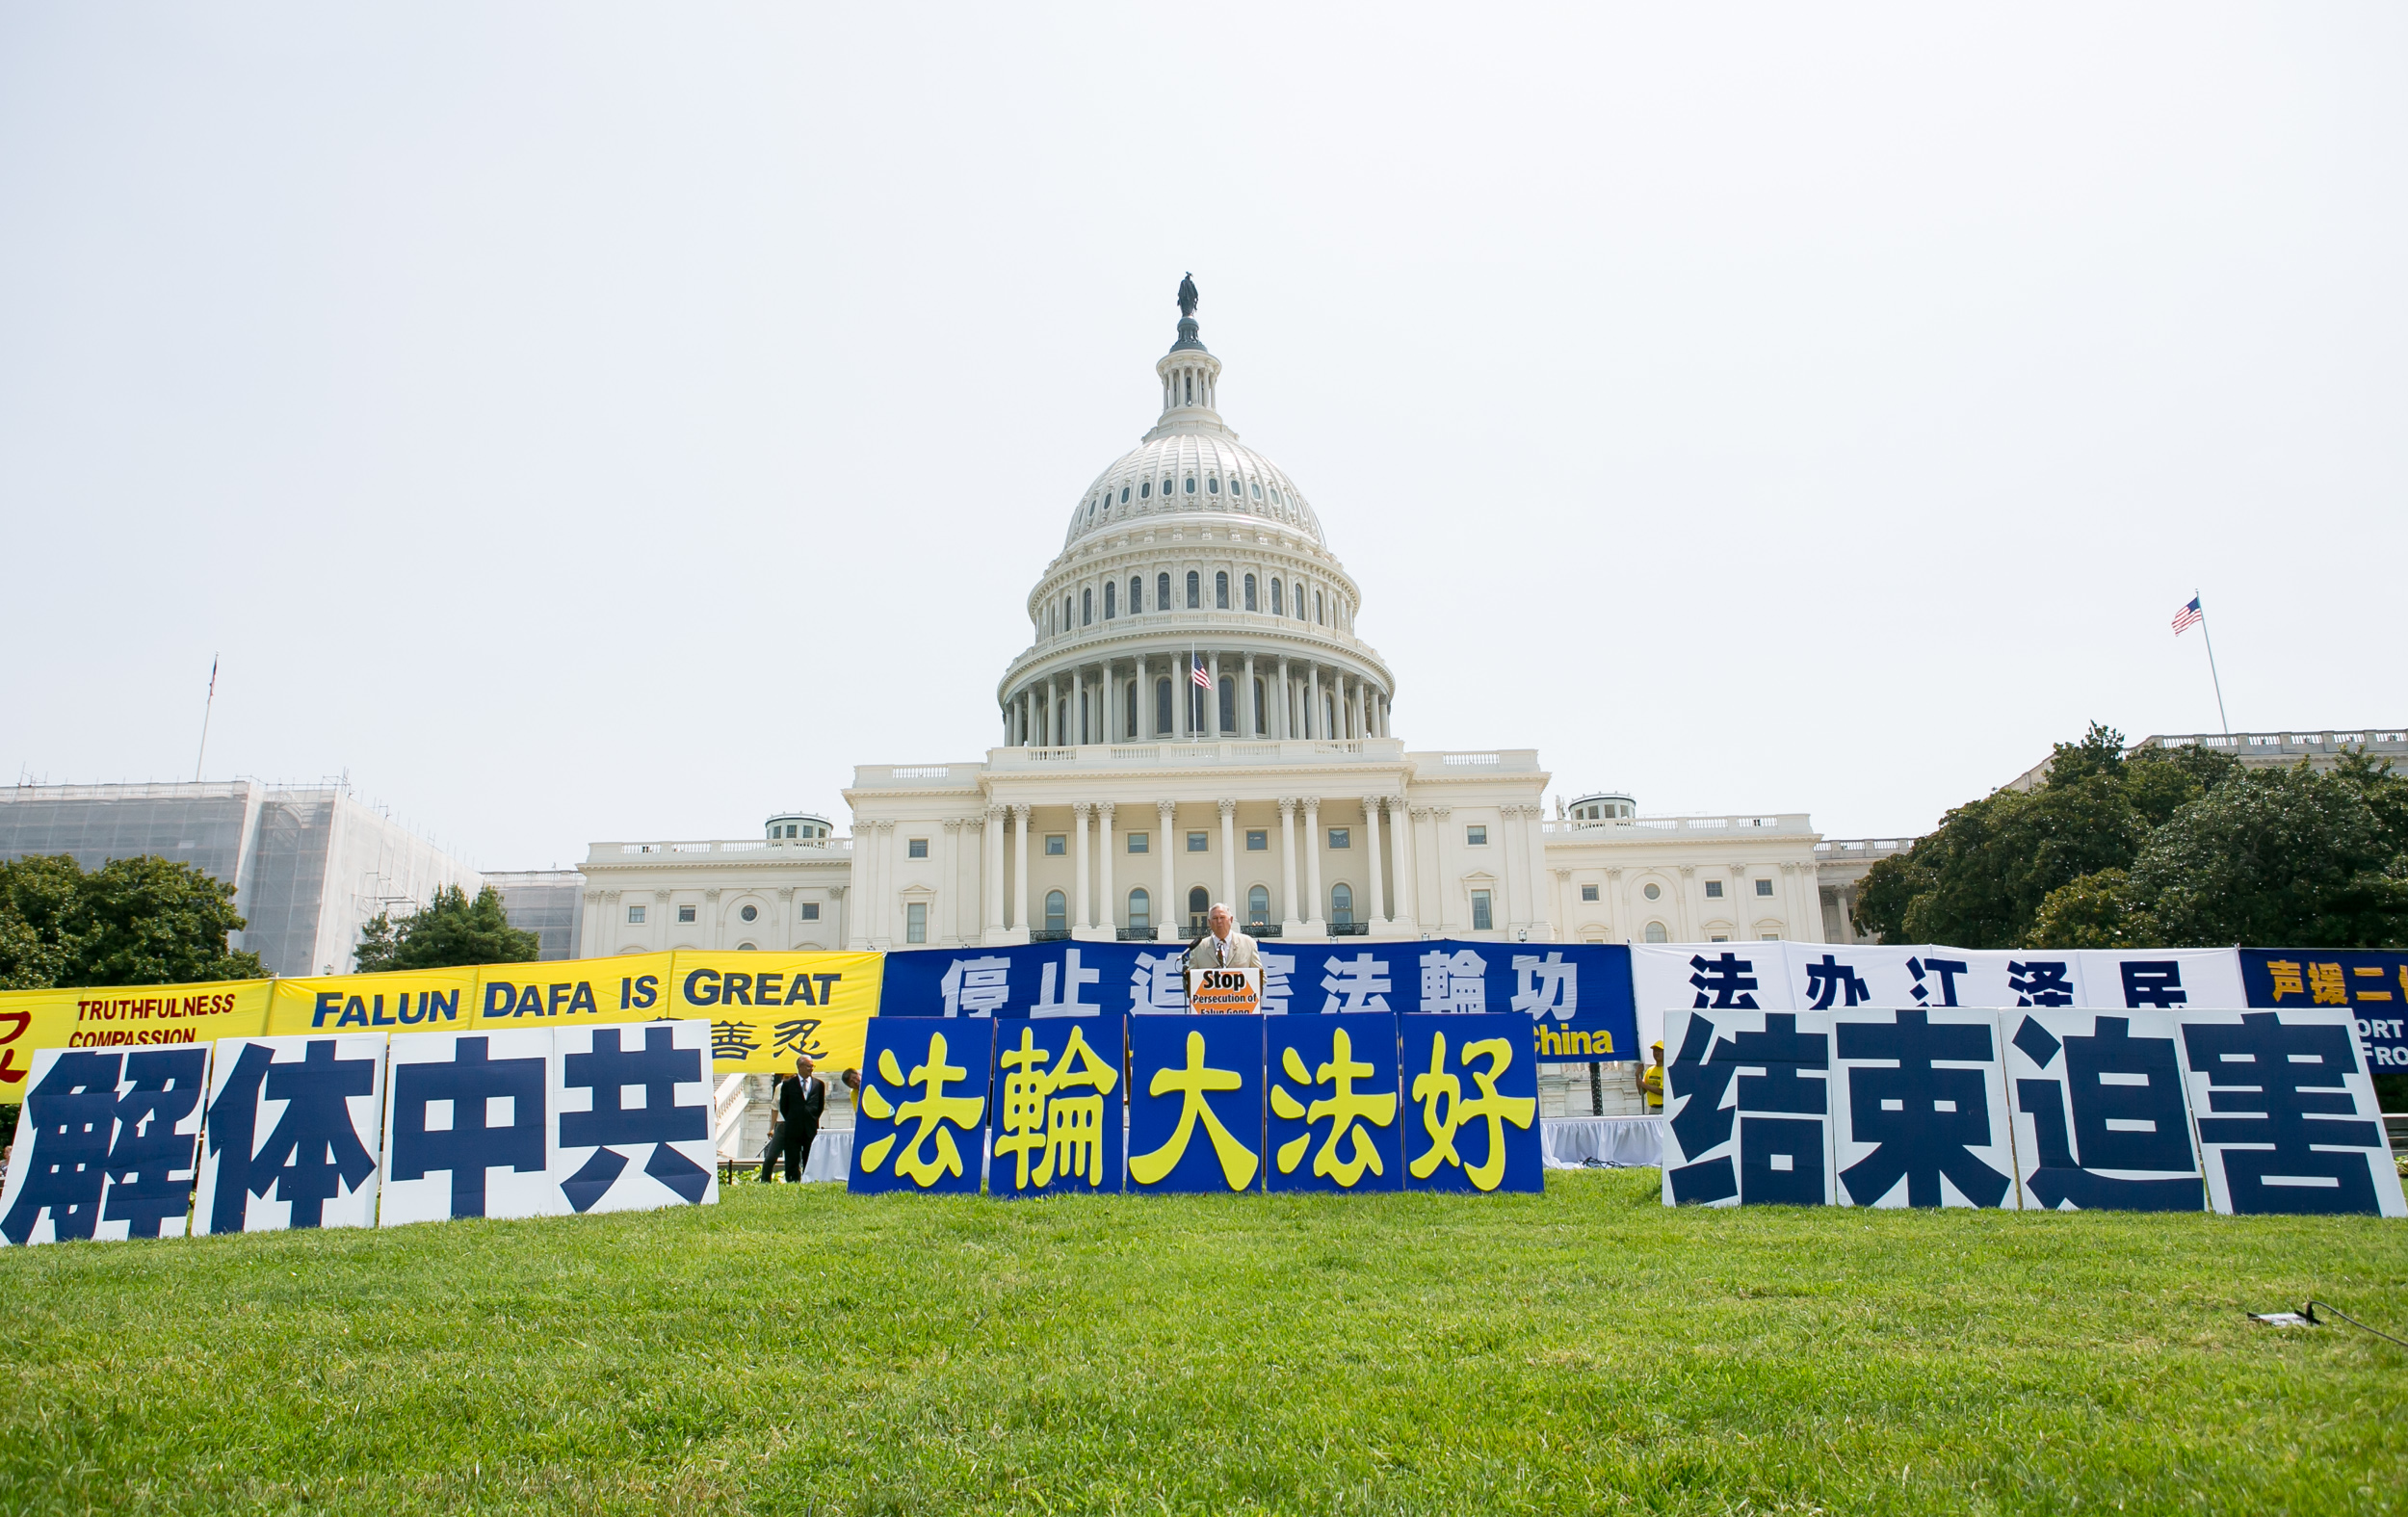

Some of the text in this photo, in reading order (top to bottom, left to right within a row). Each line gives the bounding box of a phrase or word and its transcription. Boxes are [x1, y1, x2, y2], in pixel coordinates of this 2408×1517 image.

[312, 968, 842, 1028] FALUN DAFA IS GREAT
[1192, 993, 1257, 1004] Persecution of
[1203, 970, 1245, 991] Stop
[1688, 952, 2188, 1010] 法办江泽民
[2266, 959, 2408, 1005] 声援二
[77, 993, 236, 1021] TRUTHFULNESS
[2354, 1018, 2405, 1039] ORT
[69, 1028, 196, 1048] COMPASSION
[642, 1016, 829, 1060] 善忍
[1533, 1023, 1615, 1056] hina
[860, 1024, 1536, 1192] 法輪大法好
[1666, 1008, 2383, 1216] 结束迫害
[0, 1026, 713, 1245] 解体中共
